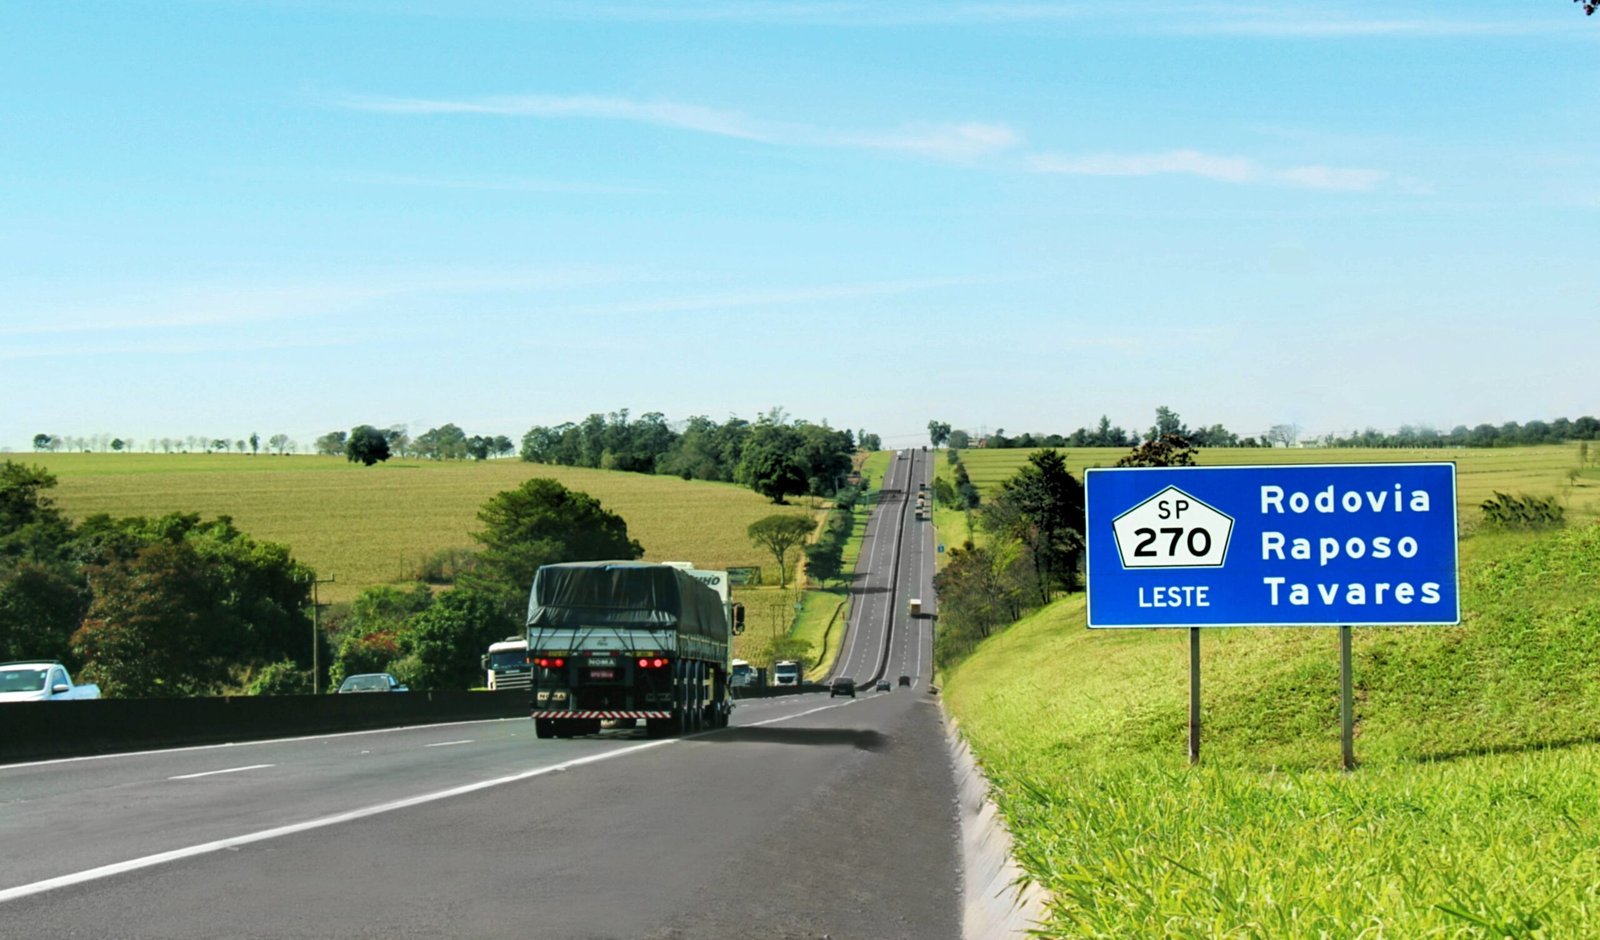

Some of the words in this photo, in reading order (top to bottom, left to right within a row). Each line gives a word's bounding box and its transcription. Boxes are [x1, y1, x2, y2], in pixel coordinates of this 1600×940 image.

[1158, 500, 1189, 519] SP
[1261, 484, 1430, 514] Rodovia
[1134, 528, 1211, 557] 270
[1262, 531, 1418, 567] Raposo
[1138, 586, 1210, 608] LESTE
[1264, 577, 1441, 606] Tavares
